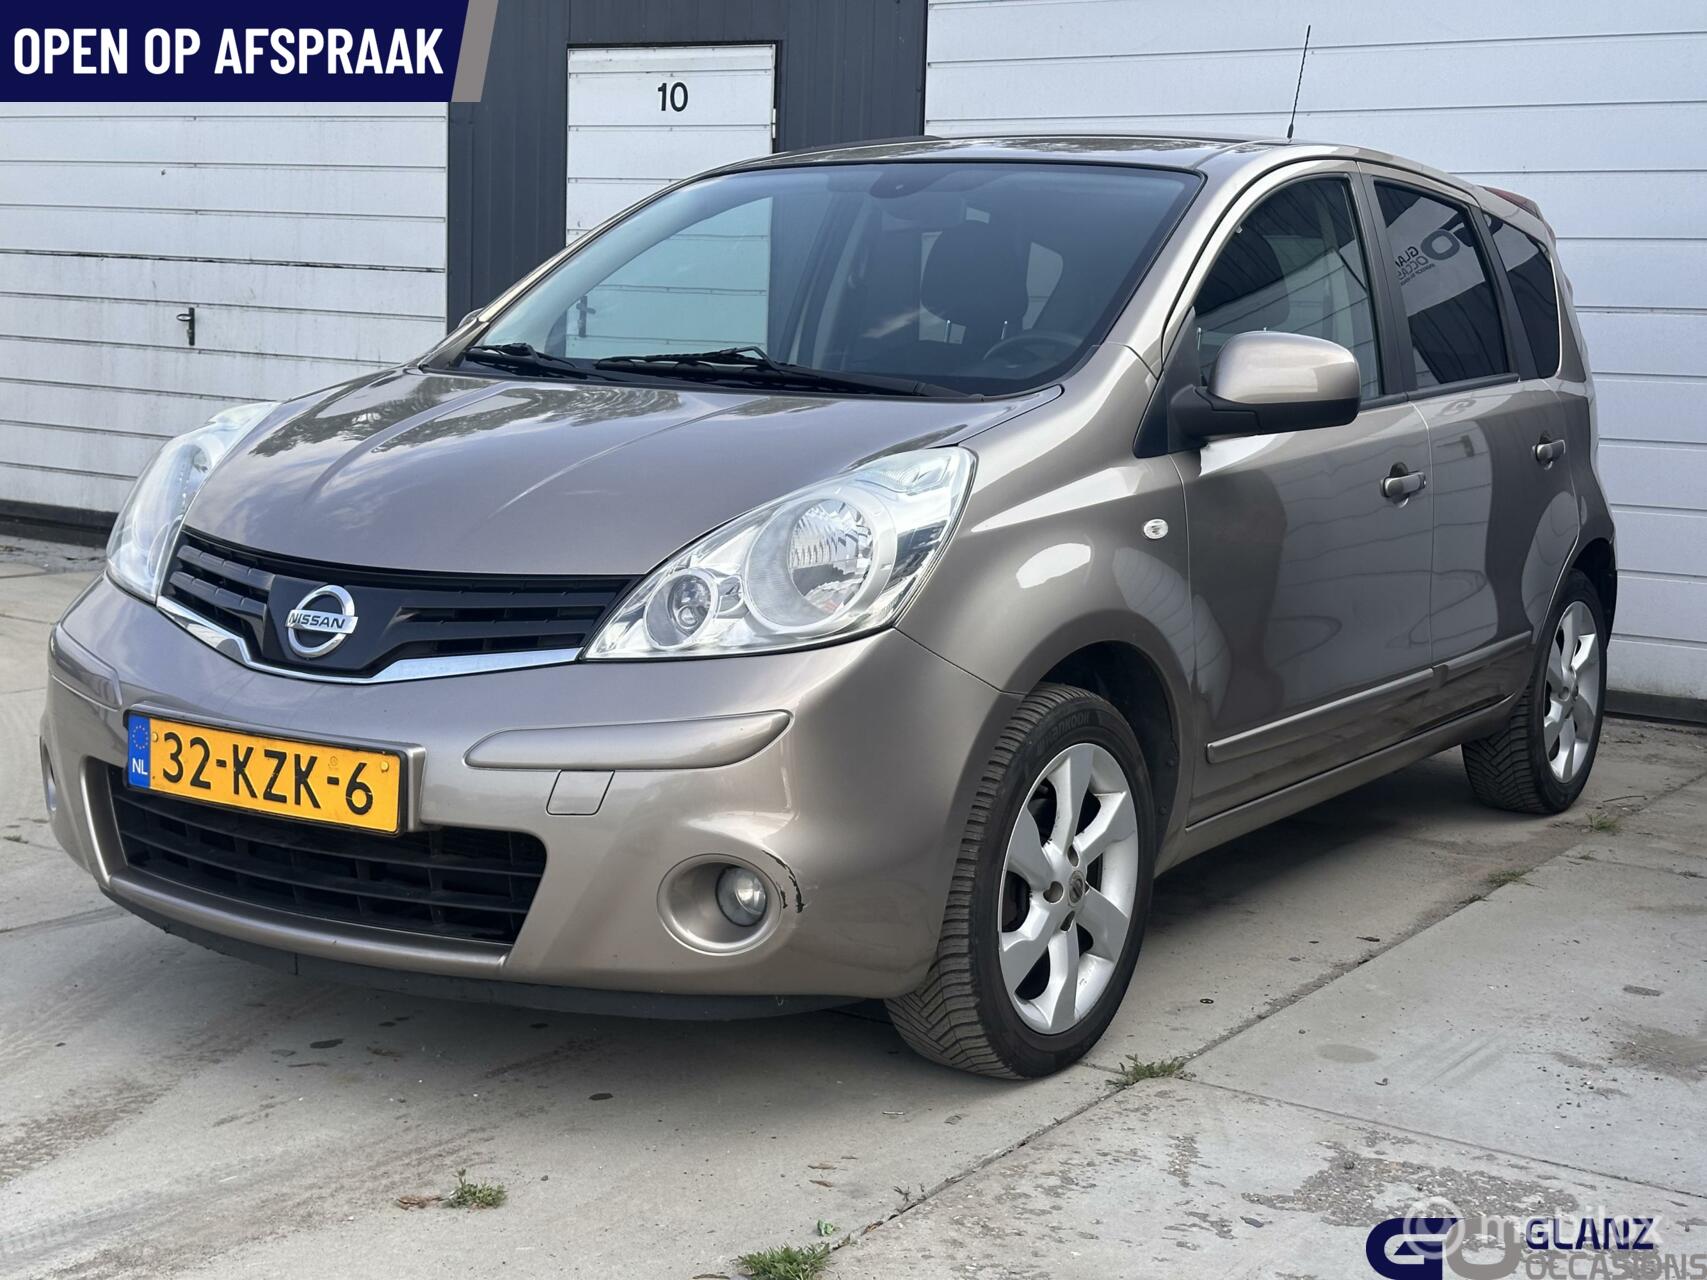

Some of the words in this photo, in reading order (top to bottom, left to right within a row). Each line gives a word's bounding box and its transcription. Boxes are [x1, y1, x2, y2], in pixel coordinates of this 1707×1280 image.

[657, 82, 689, 112] 10
[288, 612, 345, 629] NISSAN
[132, 757, 148, 775] NL
[162, 731, 374, 816] 32-KZK-6
